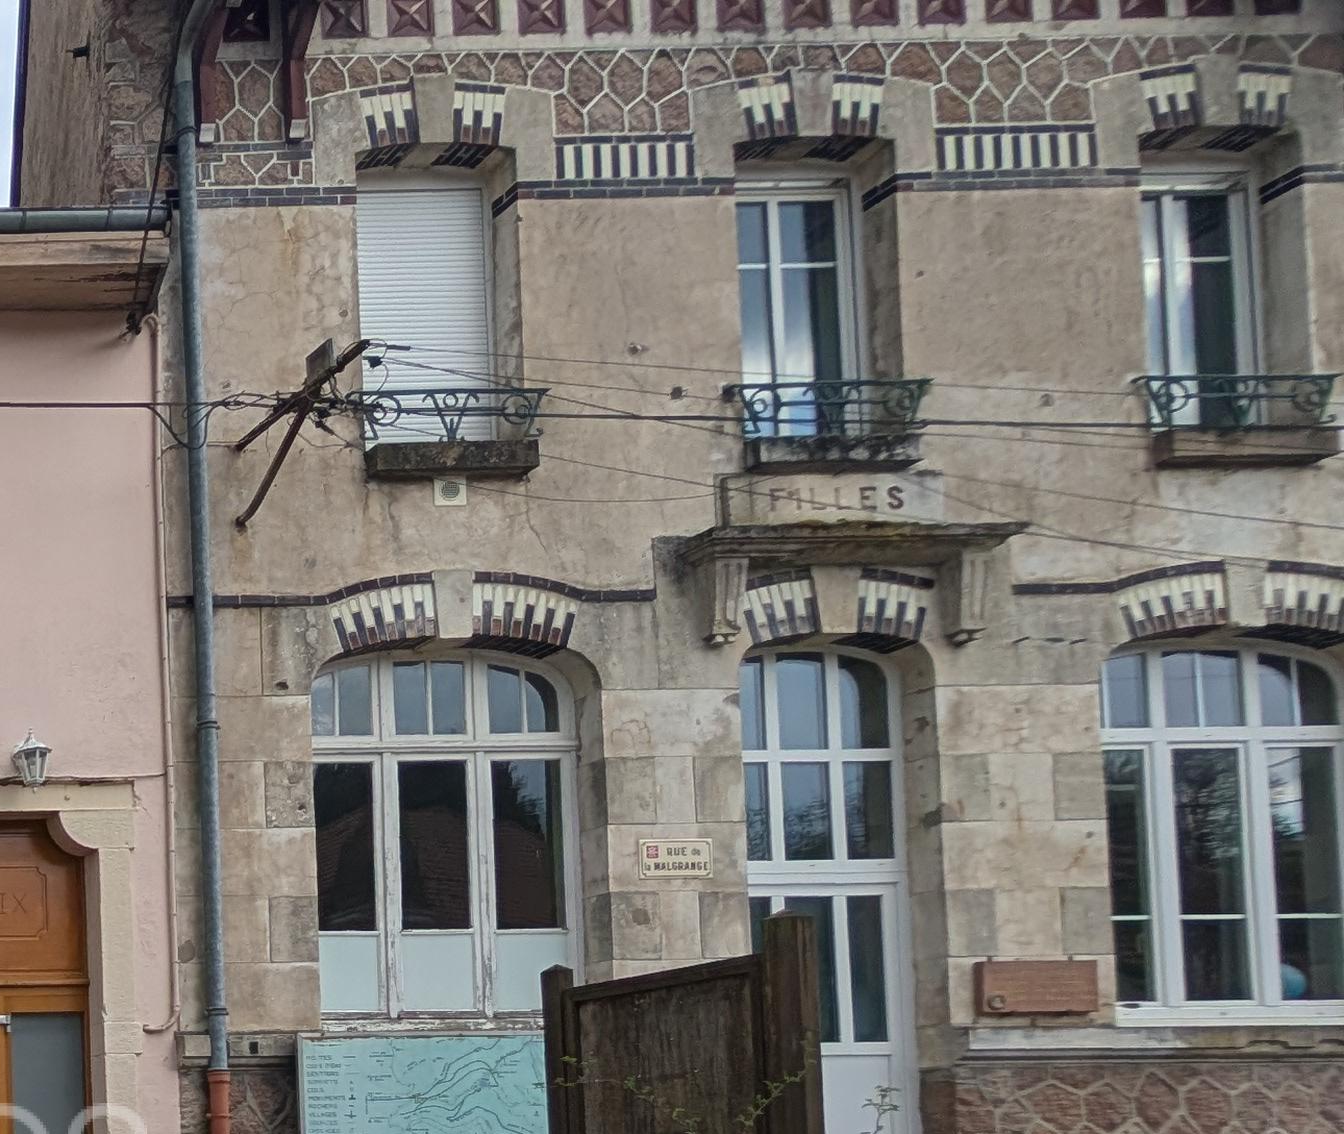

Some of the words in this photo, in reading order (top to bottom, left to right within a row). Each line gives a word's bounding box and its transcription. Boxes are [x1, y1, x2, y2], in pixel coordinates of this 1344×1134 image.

[768, 485, 905, 512] FILLES
[666, 847, 688, 857] RUE
[654, 861, 709, 871] MALGRANGE
